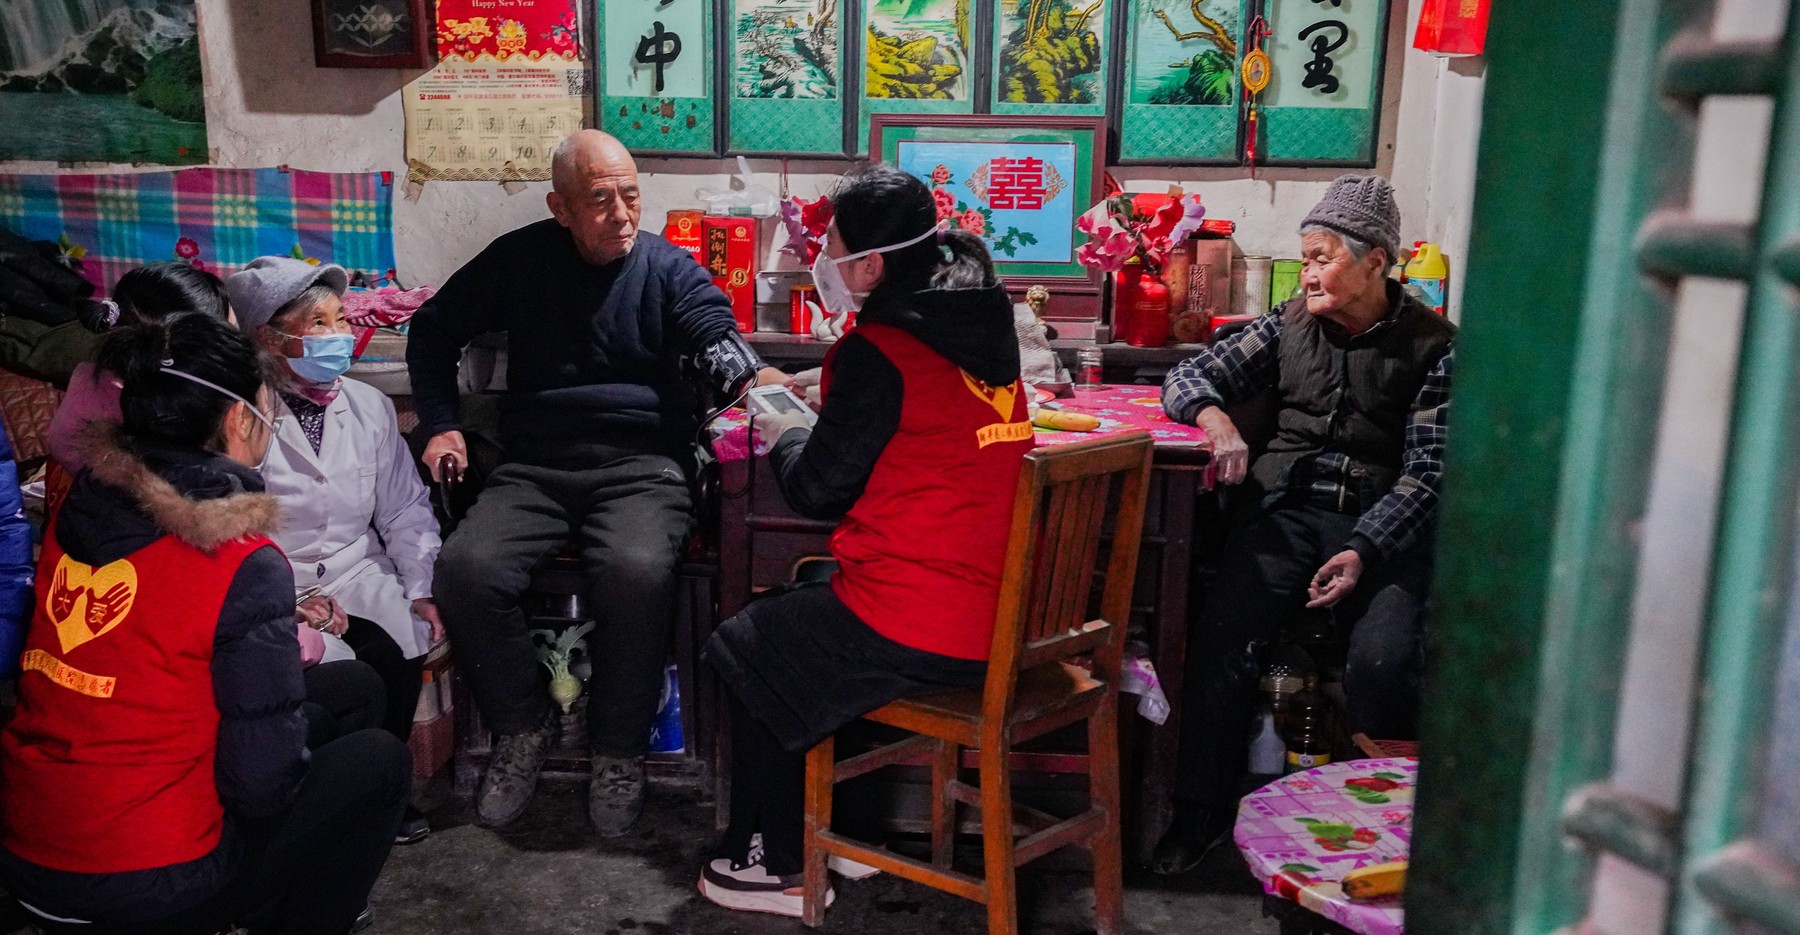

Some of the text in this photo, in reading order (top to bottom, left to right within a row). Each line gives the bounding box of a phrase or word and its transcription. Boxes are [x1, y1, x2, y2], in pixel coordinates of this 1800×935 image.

[472, 0, 496, 9] Happy
[635, 21, 682, 92] 中
[735, 270, 746, 284] 9
